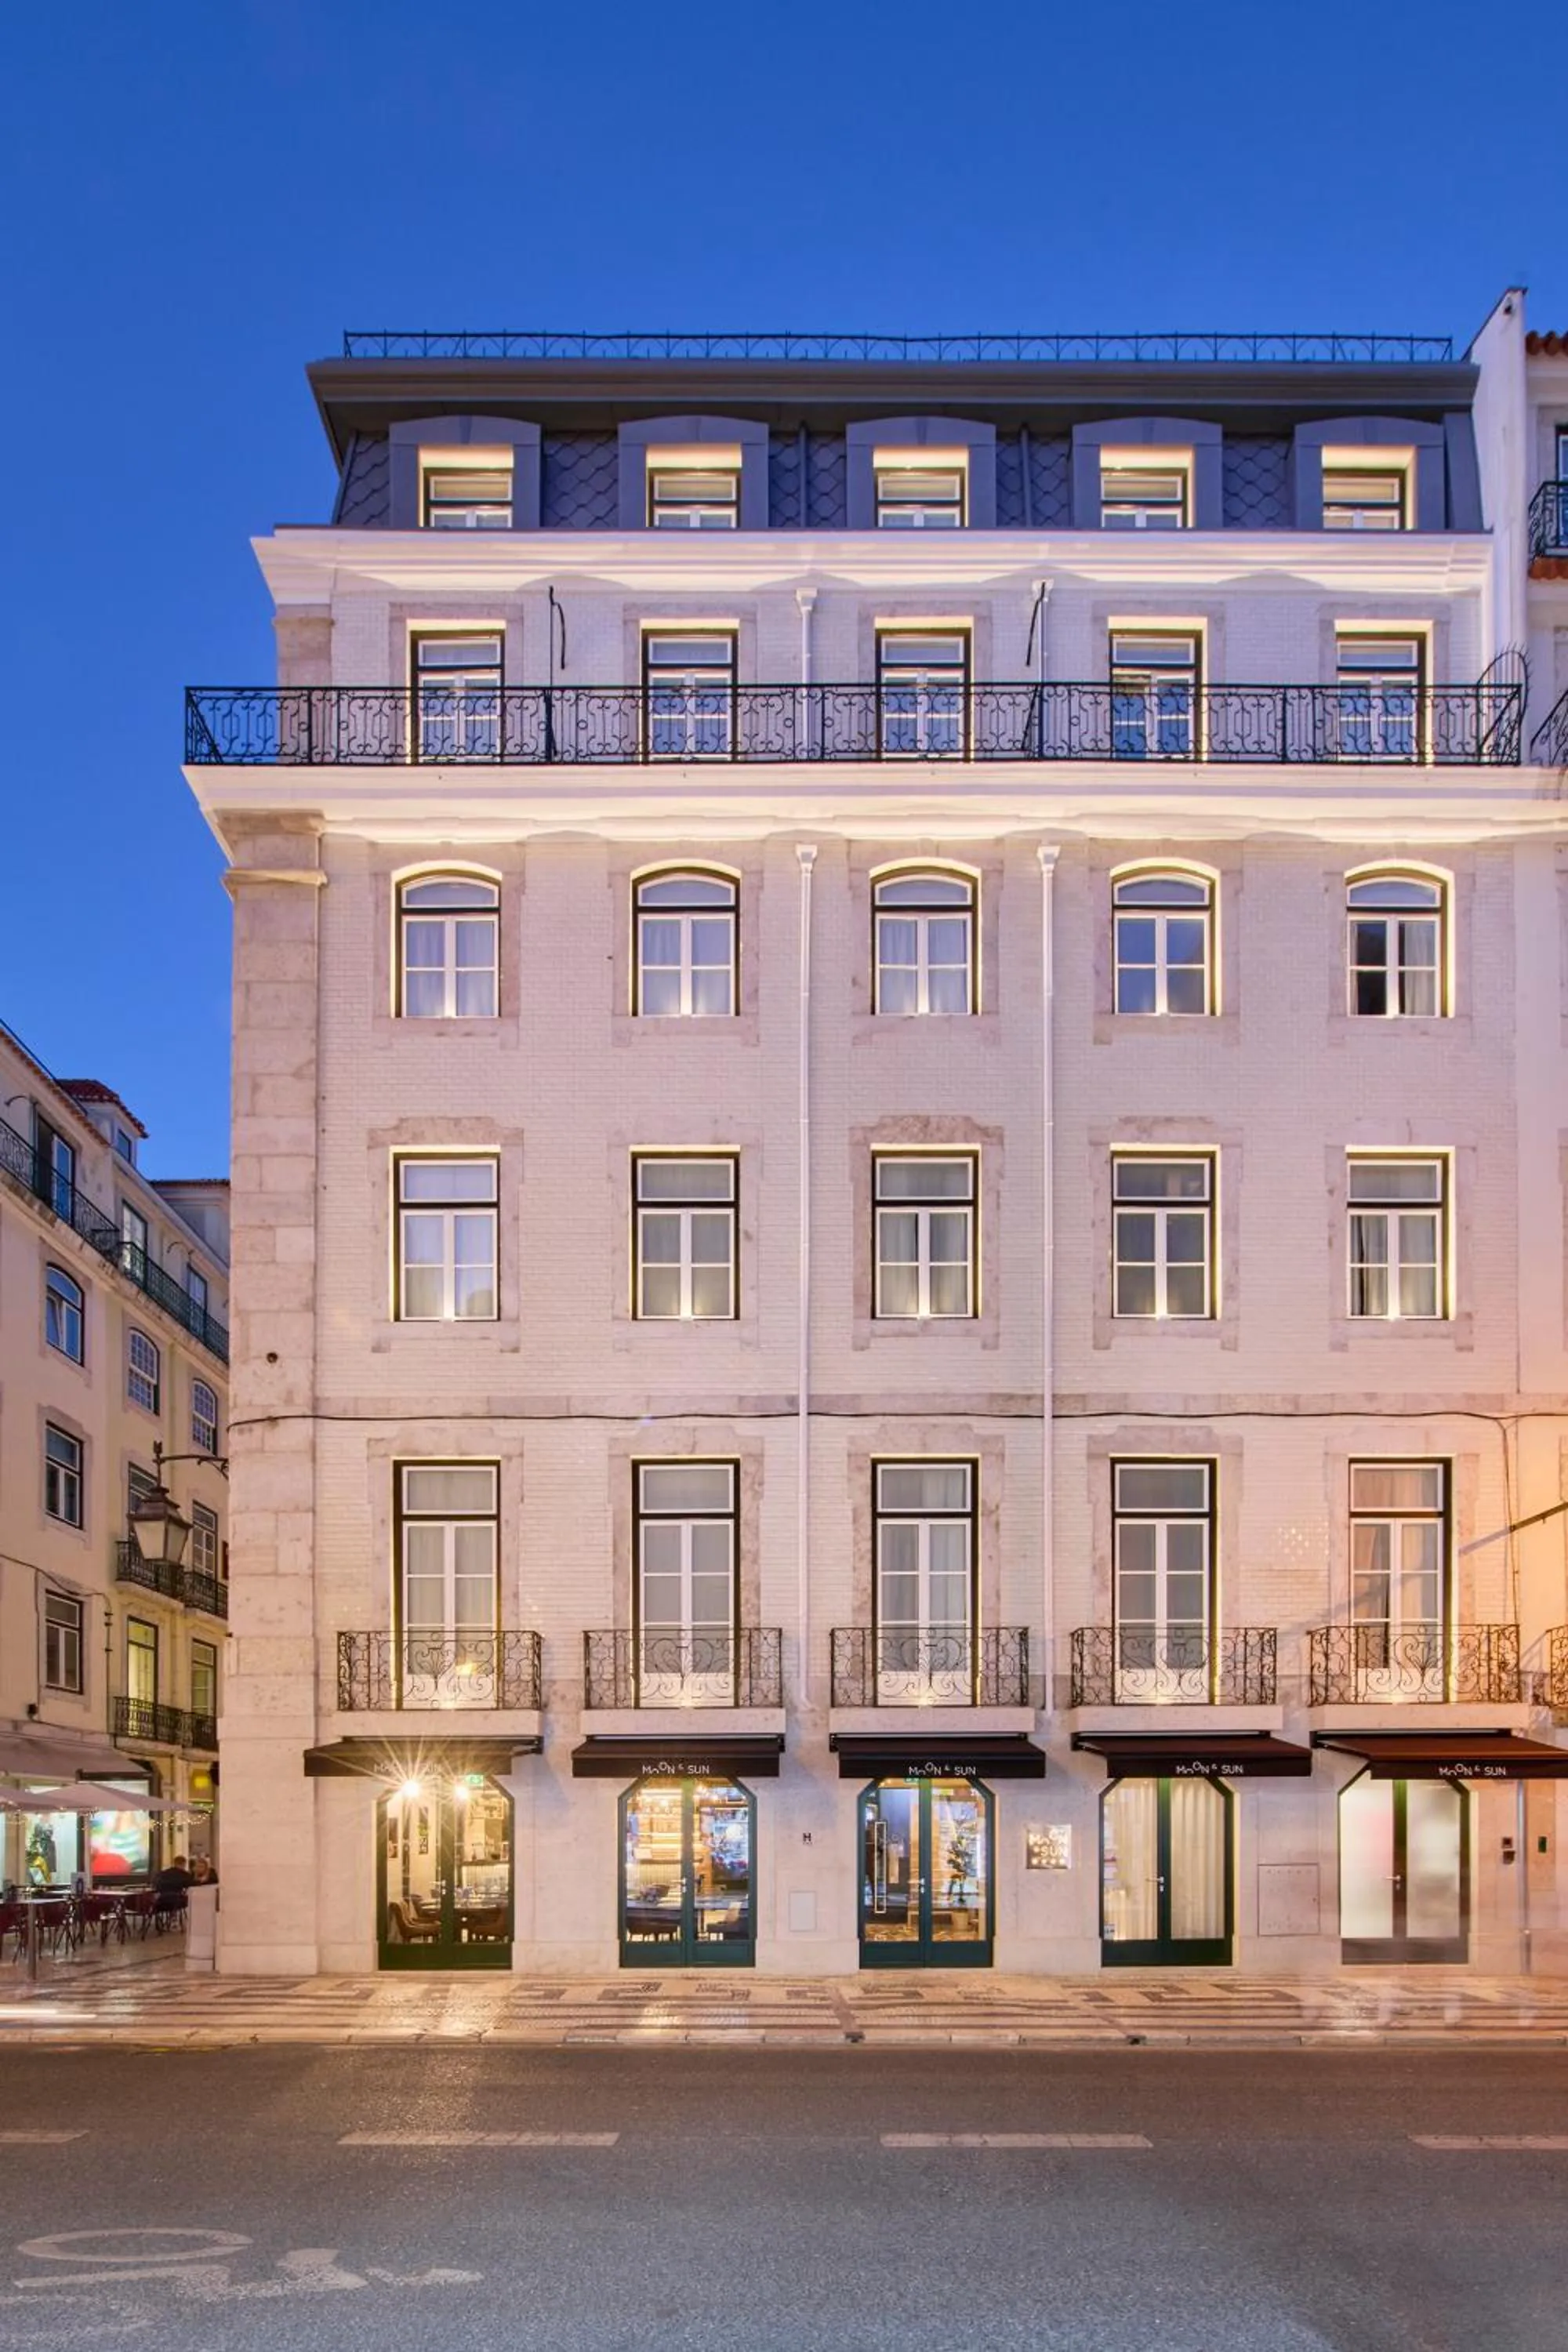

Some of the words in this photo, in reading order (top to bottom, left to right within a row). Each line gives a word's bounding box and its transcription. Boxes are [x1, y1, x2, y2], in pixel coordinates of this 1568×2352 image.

[688, 1765, 710, 1774] SUN
[954, 1766, 976, 1776] SUN
[1221, 1765, 1243, 1774] SUN
[1484, 1766, 1506, 1776] SUN
